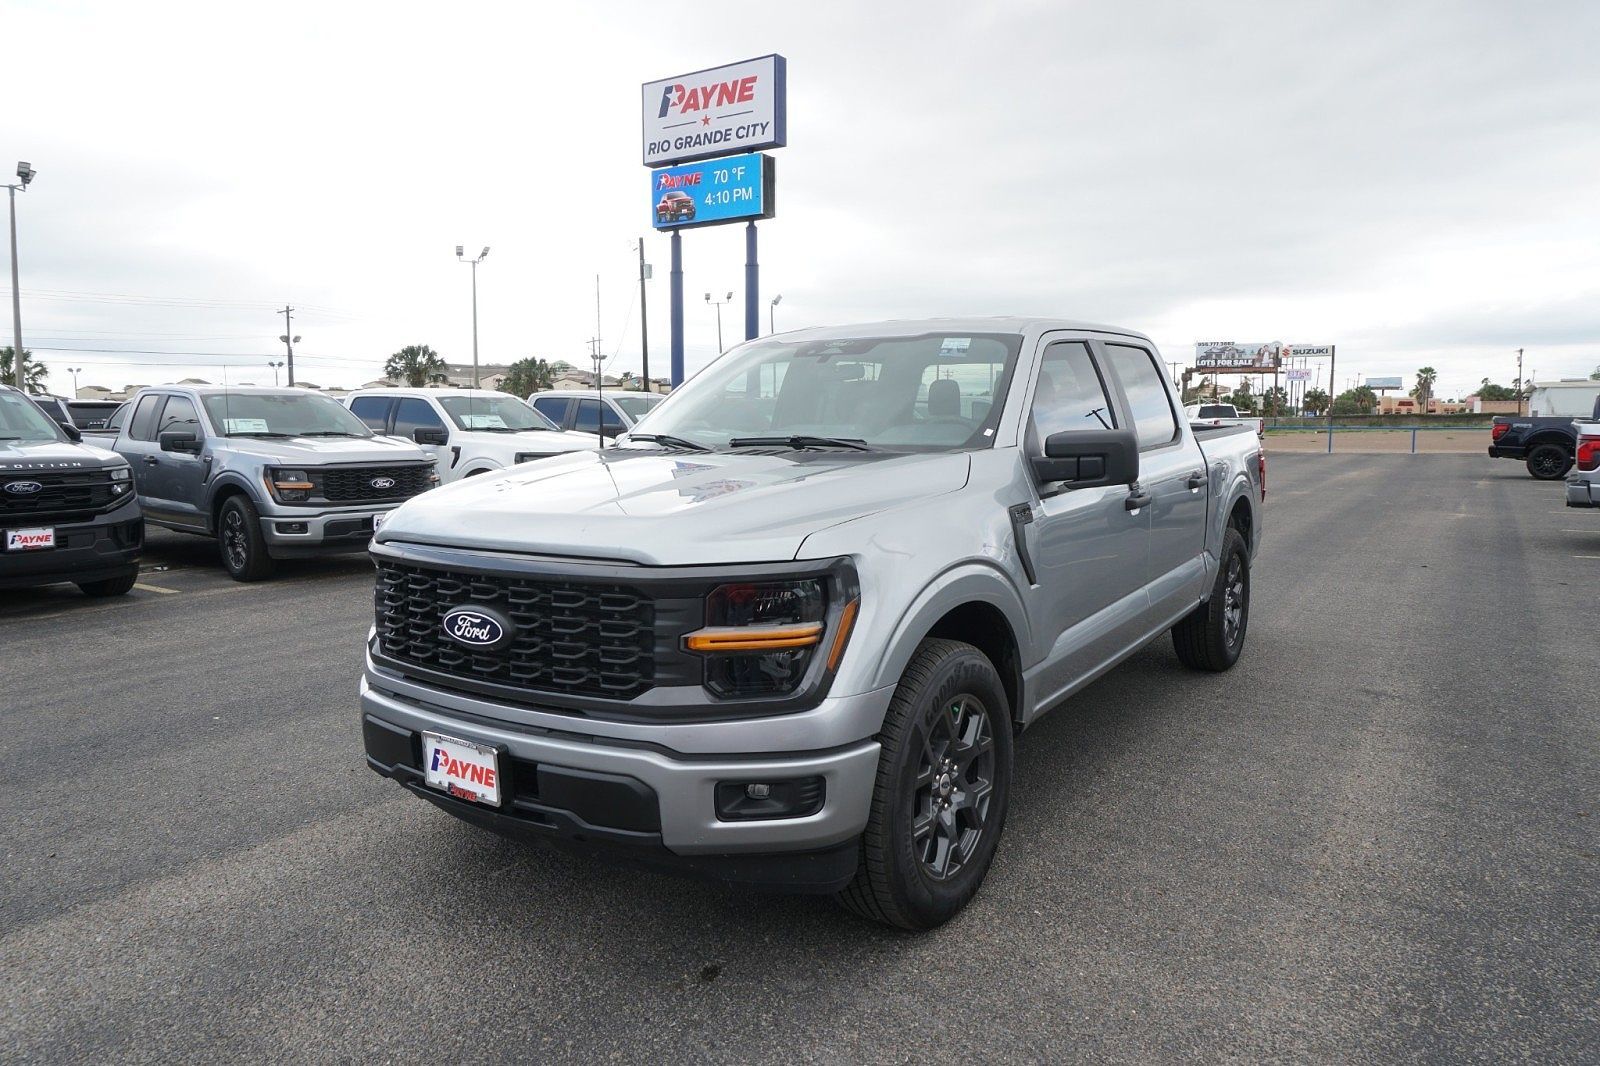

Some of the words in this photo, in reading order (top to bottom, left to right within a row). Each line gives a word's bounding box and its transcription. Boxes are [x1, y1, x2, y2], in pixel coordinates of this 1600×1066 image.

[658, 75, 758, 118] PAYNE
[648, 140, 671, 155] RIO
[674, 128, 733, 150] GRANDE
[736, 121, 770, 139] CITY
[656, 172, 703, 190] PAYNE
[713, 169, 728, 184] 70
[704, 190, 730, 206] 4:10
[733, 186, 753, 202] PM
[11, 482, 36, 493] Ford
[10, 534, 52, 545] PAYNE
[453, 614, 491, 641] Ford
[431, 748, 496, 788] PAYNE
